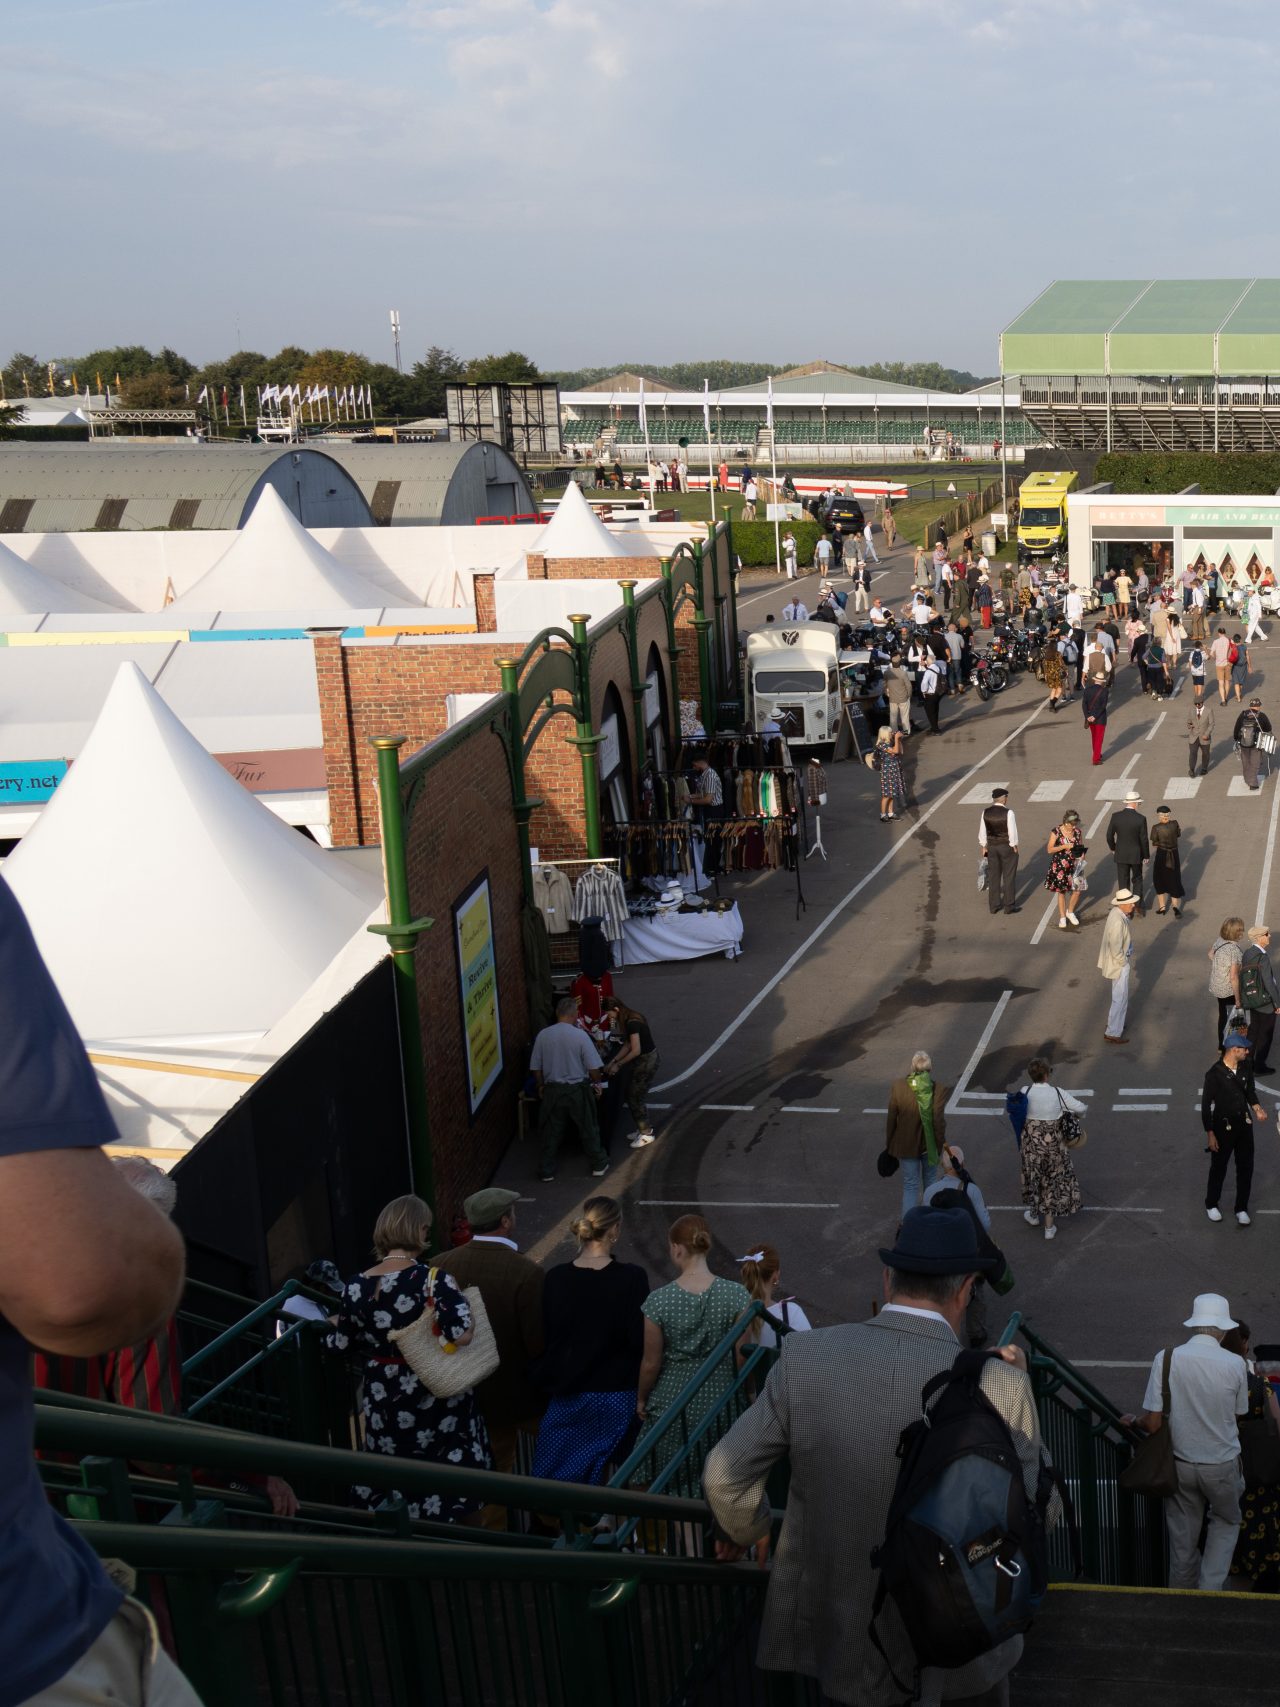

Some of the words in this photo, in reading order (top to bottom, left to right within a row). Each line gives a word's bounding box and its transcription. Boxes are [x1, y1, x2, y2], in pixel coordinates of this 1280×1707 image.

[1098, 511, 1157, 520] BETTY'S
[1189, 513, 1220, 521] HAIR
[1223, 513, 1248, 521] AND
[228, 760, 266, 783] Fur
[967, 1538, 1004, 1563] macpac
